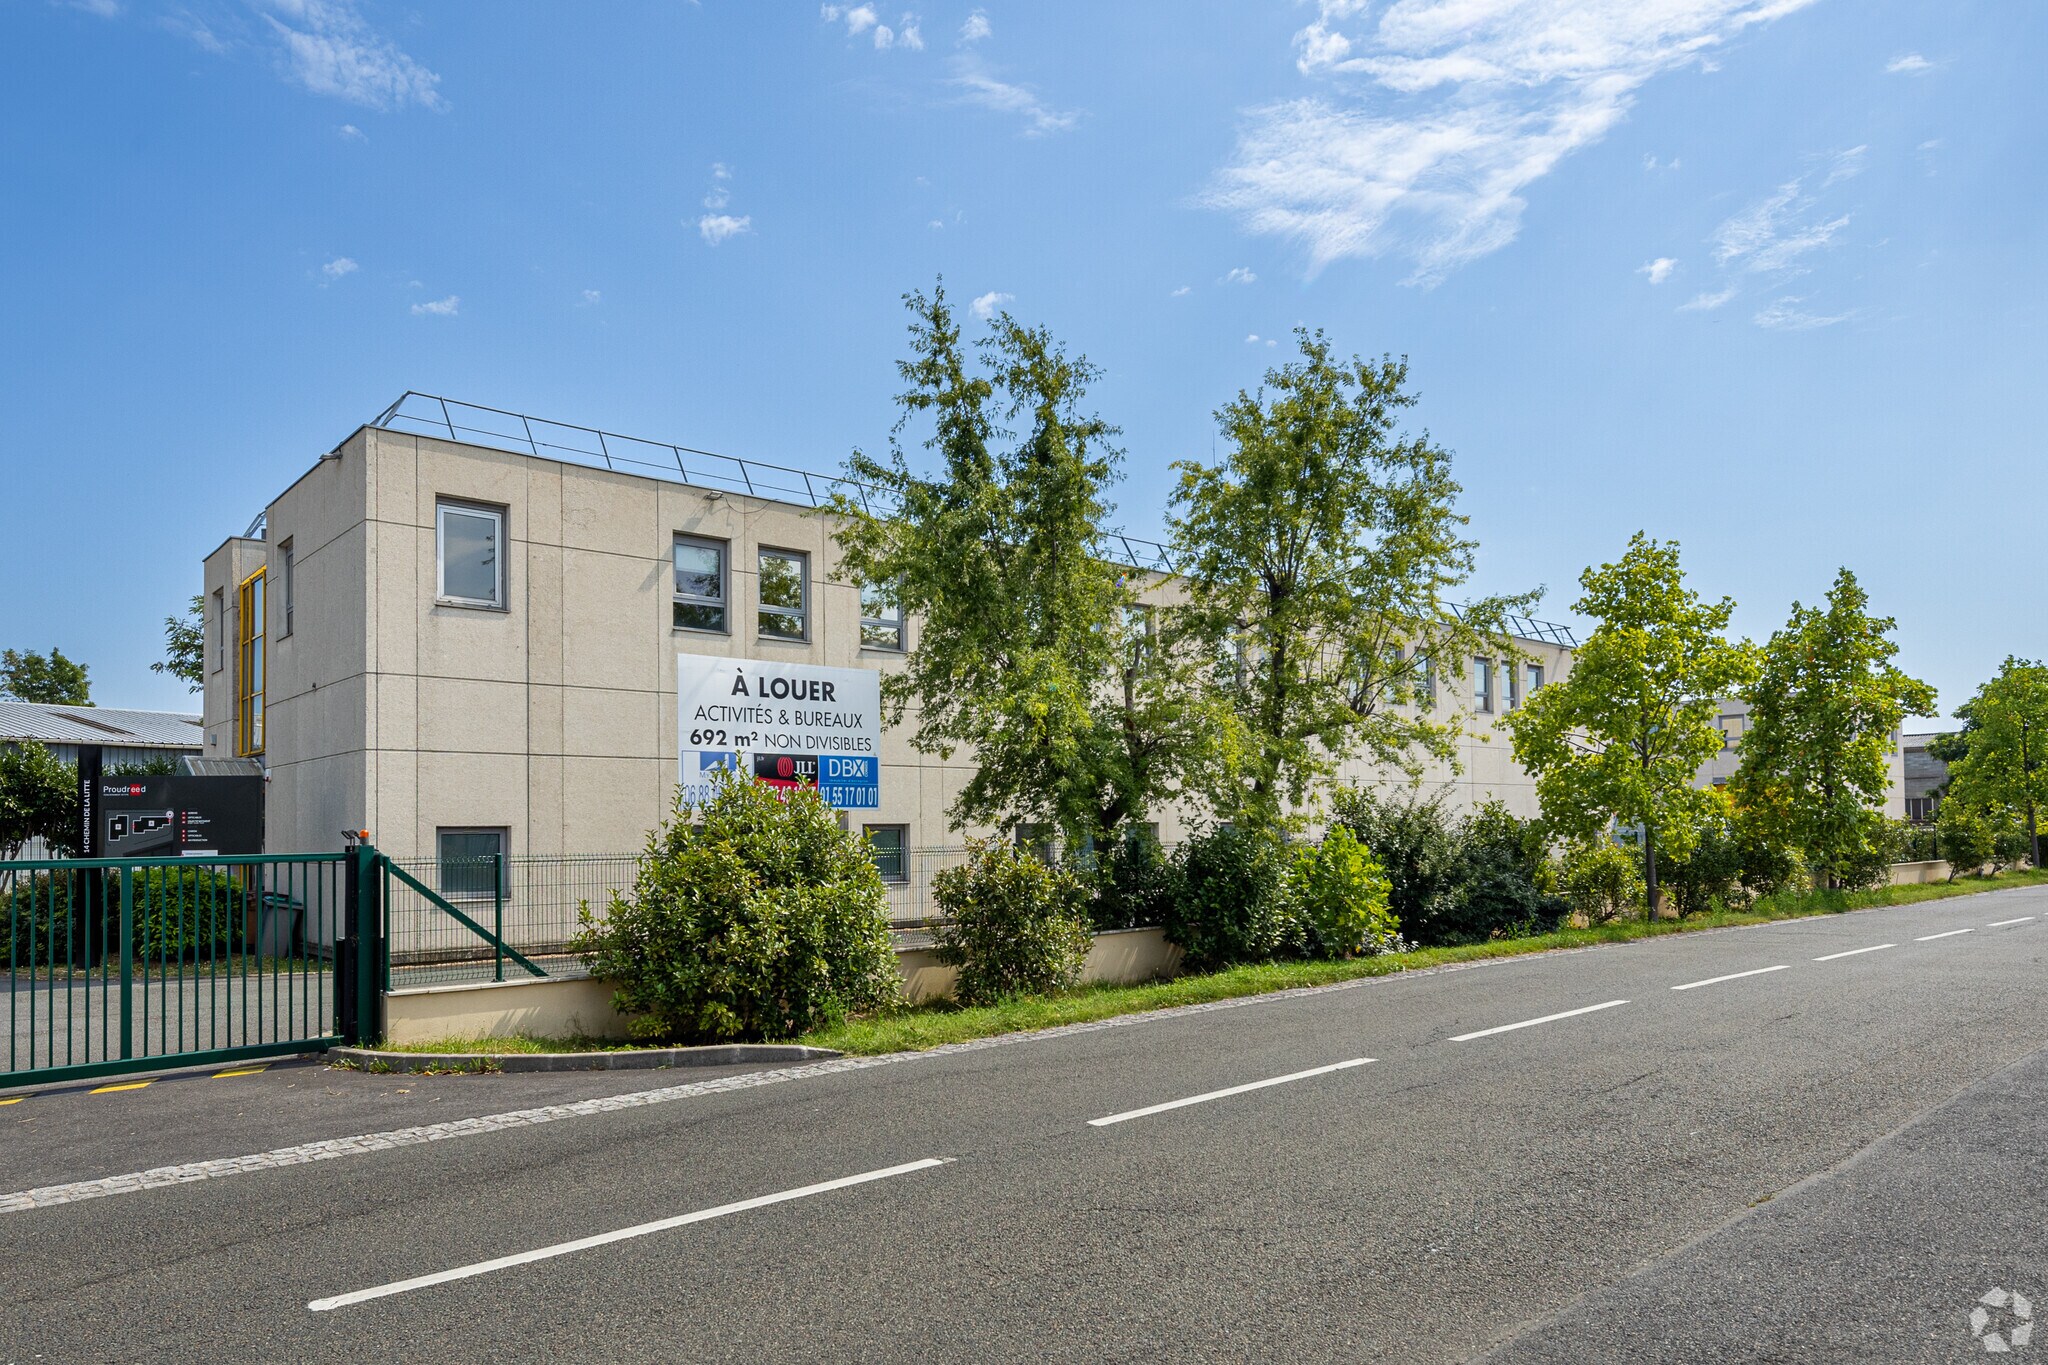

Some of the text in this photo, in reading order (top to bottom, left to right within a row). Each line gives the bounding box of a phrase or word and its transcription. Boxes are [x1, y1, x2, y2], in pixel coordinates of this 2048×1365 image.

[731, 667, 836, 702] À LOUER
[694, 703, 863, 728] ACTIVITÉS & BUREAUX
[689, 729, 872, 751] 692 m² NON DIVISIBLES
[793, 760, 816, 775] JLL
[828, 758, 865, 777] DBX
[83, 779, 91, 798] LITTE
[103, 785, 147, 793] Proudreed
[832, 786, 843, 806] 55
[845, 786, 855, 806] 17
[856, 786, 866, 806] 01
[868, 787, 878, 806] 01
[83, 798, 90, 807] LA
[83, 807, 90, 817] DE
[83, 845, 90, 853] 14
